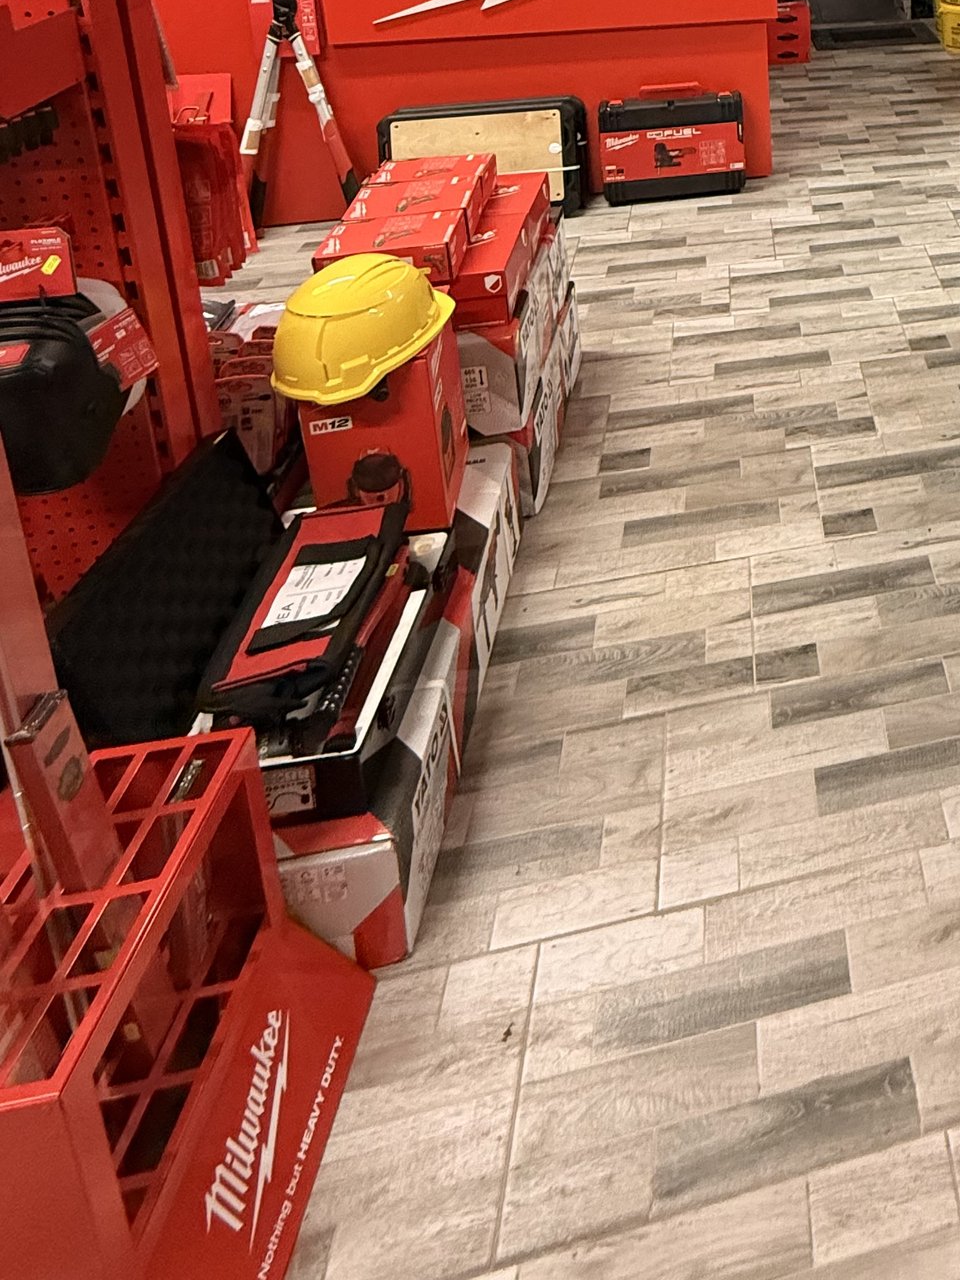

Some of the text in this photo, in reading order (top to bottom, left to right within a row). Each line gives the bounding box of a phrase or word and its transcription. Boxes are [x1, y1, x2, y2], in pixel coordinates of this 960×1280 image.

[664, 128, 701, 136] FUEL
[605, 133, 640, 148] Milwaukee
[0, 255, 42, 272] lwaukee
[312, 418, 350, 433] M12
[204, 1009, 282, 1234] Milwaukee
[257, 1199, 293, 1280] Nothing
[285, 1162, 303, 1197] but
[298, 1089, 326, 1160] HEAVY
